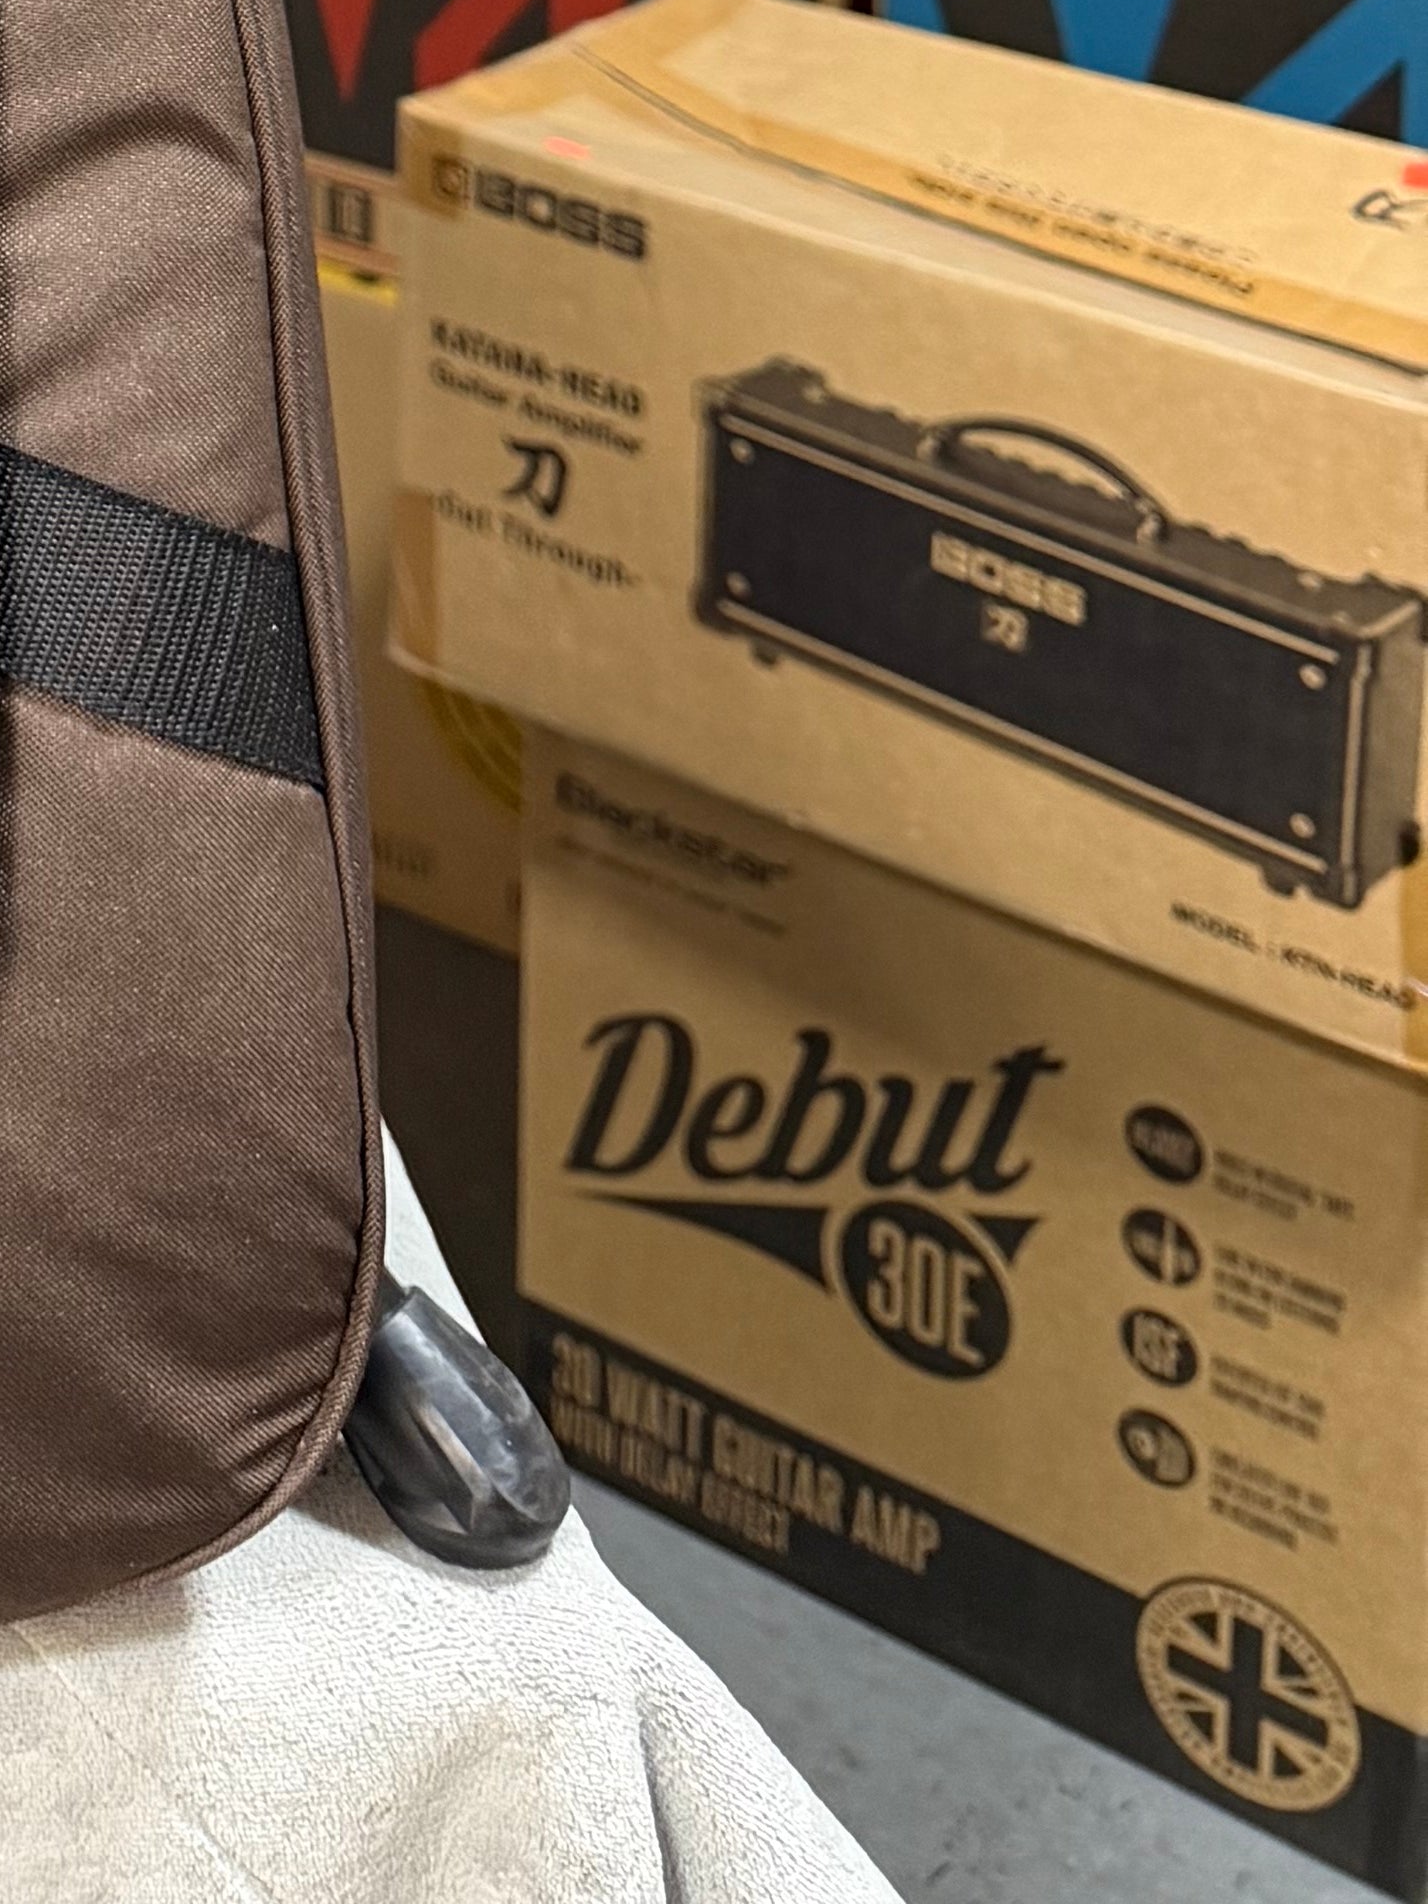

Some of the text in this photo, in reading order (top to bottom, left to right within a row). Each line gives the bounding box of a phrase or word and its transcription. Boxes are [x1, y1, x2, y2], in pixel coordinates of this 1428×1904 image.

[473, 163, 650, 261] BOSS
[929, 529, 1087, 627] BOSS
[1170, 901, 1261, 954] MODEL
[561, 1008, 1067, 1193] Debut
[866, 1219, 986, 1368] 30E
[605, 1359, 706, 1461] WATT
[712, 1412, 845, 1535] GUITAR
[850, 1482, 943, 1576] AMP
